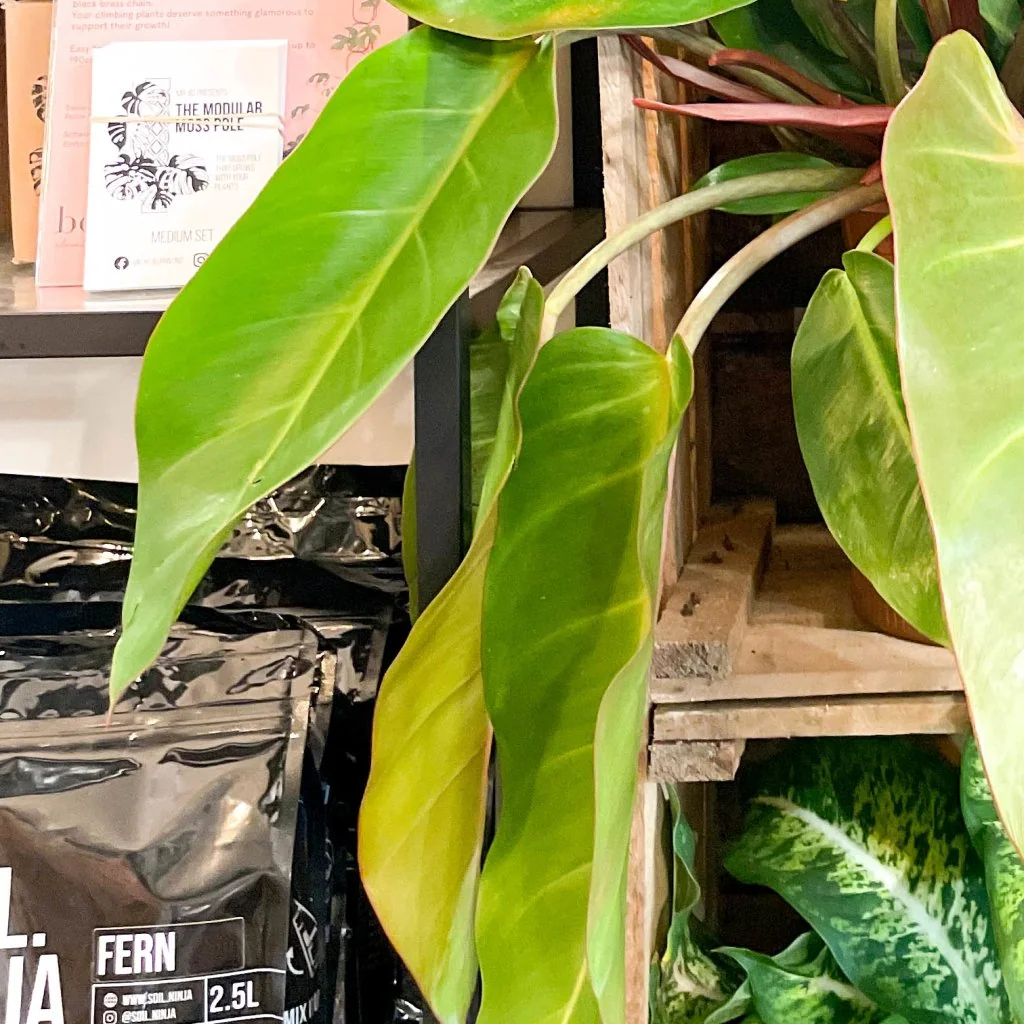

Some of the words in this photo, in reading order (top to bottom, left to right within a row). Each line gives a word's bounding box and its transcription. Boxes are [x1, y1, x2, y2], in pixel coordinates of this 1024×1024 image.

[95, 10, 133, 21] climbing
[136, 9, 164, 20] plants
[205, 8, 252, 20] something
[71, 21, 108, 32] support
[110, 21, 133, 30] their
[175, 102, 199, 116] THE
[203, 101, 263, 116] MODULAR
[175, 118, 210, 133] MOSS
[214, 117, 244, 131] POLE
[151, 229, 193, 244] MEDIUM
[195, 228, 213, 243] SET
[97, 931, 177, 976] FERN
[209, 980, 260, 1013] 2.5L
